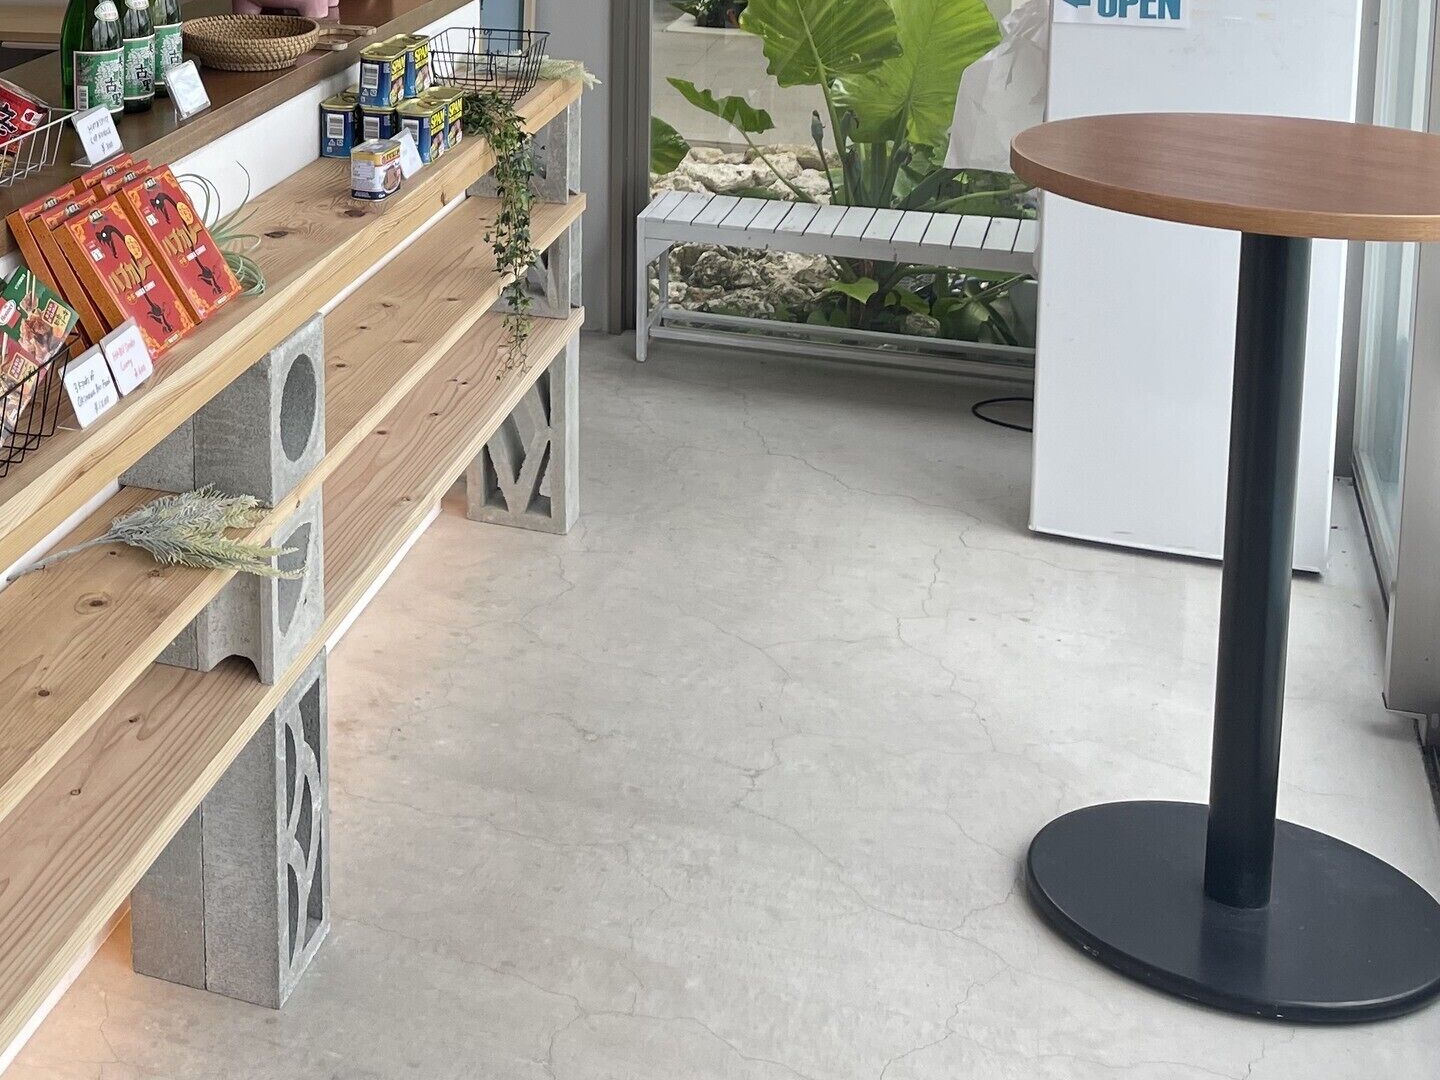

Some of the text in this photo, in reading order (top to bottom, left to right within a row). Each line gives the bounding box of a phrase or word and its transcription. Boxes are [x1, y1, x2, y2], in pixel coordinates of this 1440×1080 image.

[414, 42, 429, 61] SPAM
[391, 55, 406, 75] SPAM
[448, 97, 463, 117] SPAM
[430, 109, 445, 130] SPAM
